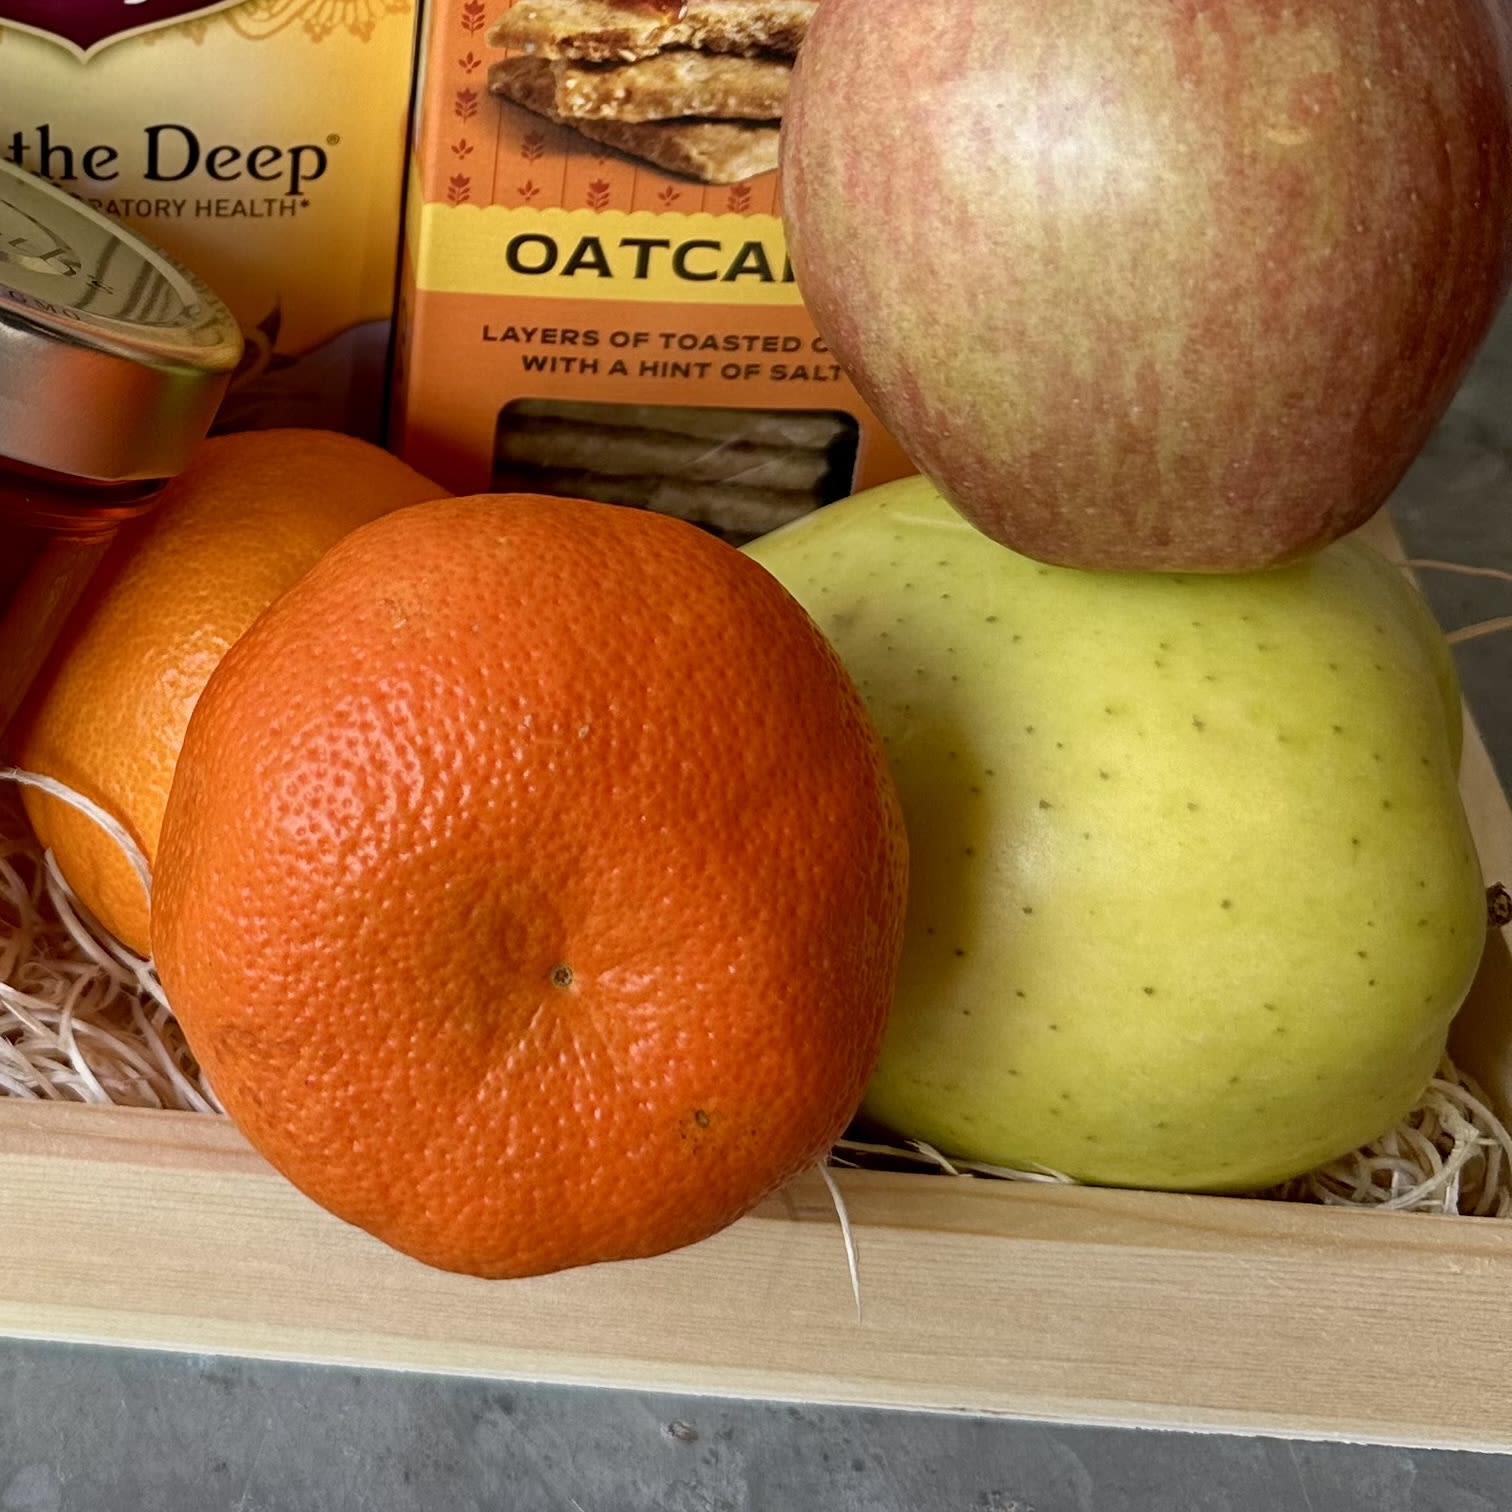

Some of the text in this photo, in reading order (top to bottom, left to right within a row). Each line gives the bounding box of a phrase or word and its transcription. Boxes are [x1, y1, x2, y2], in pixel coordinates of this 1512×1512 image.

[482, 324, 600, 347] LAYERS
[609, 330, 650, 350] OF
[659, 332, 802, 354] TOASTED
[521, 354, 843, 383] WITH A HINT OF SALT
